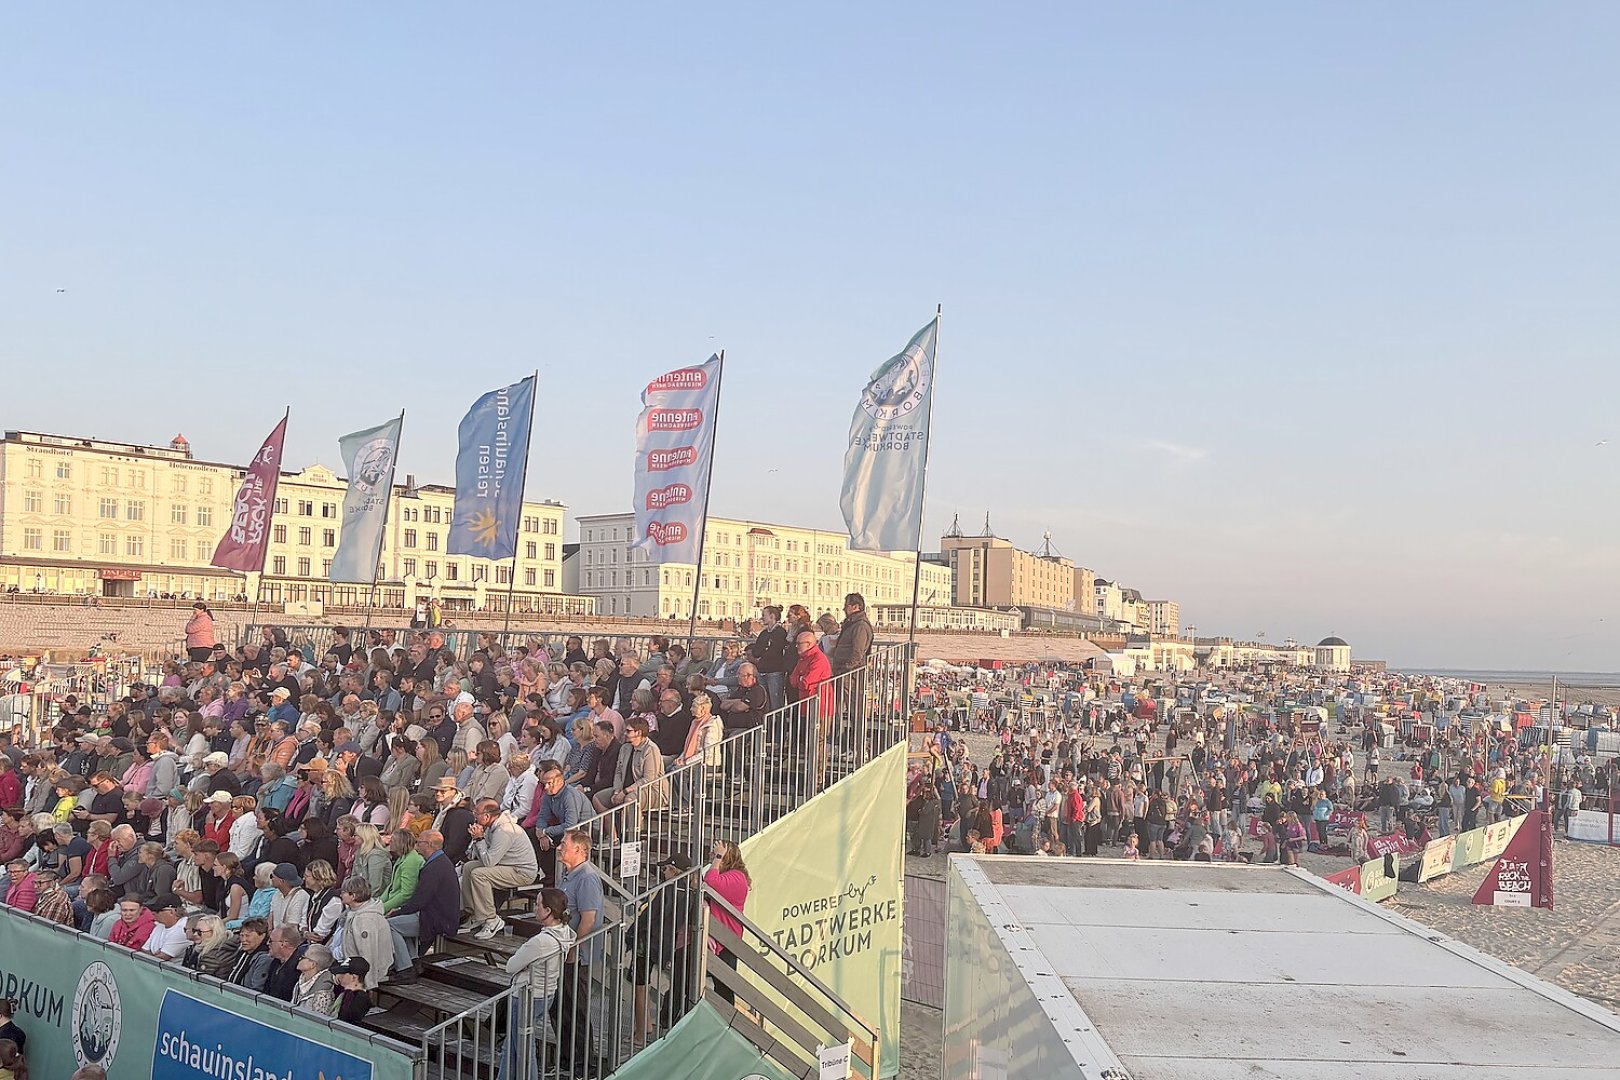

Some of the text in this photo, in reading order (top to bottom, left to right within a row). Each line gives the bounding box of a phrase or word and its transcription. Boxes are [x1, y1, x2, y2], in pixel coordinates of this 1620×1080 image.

[26, 446, 74, 457] Strandhotel
[1498, 880, 1532, 892] BEACH
[0, 970, 64, 1028] RKUM
